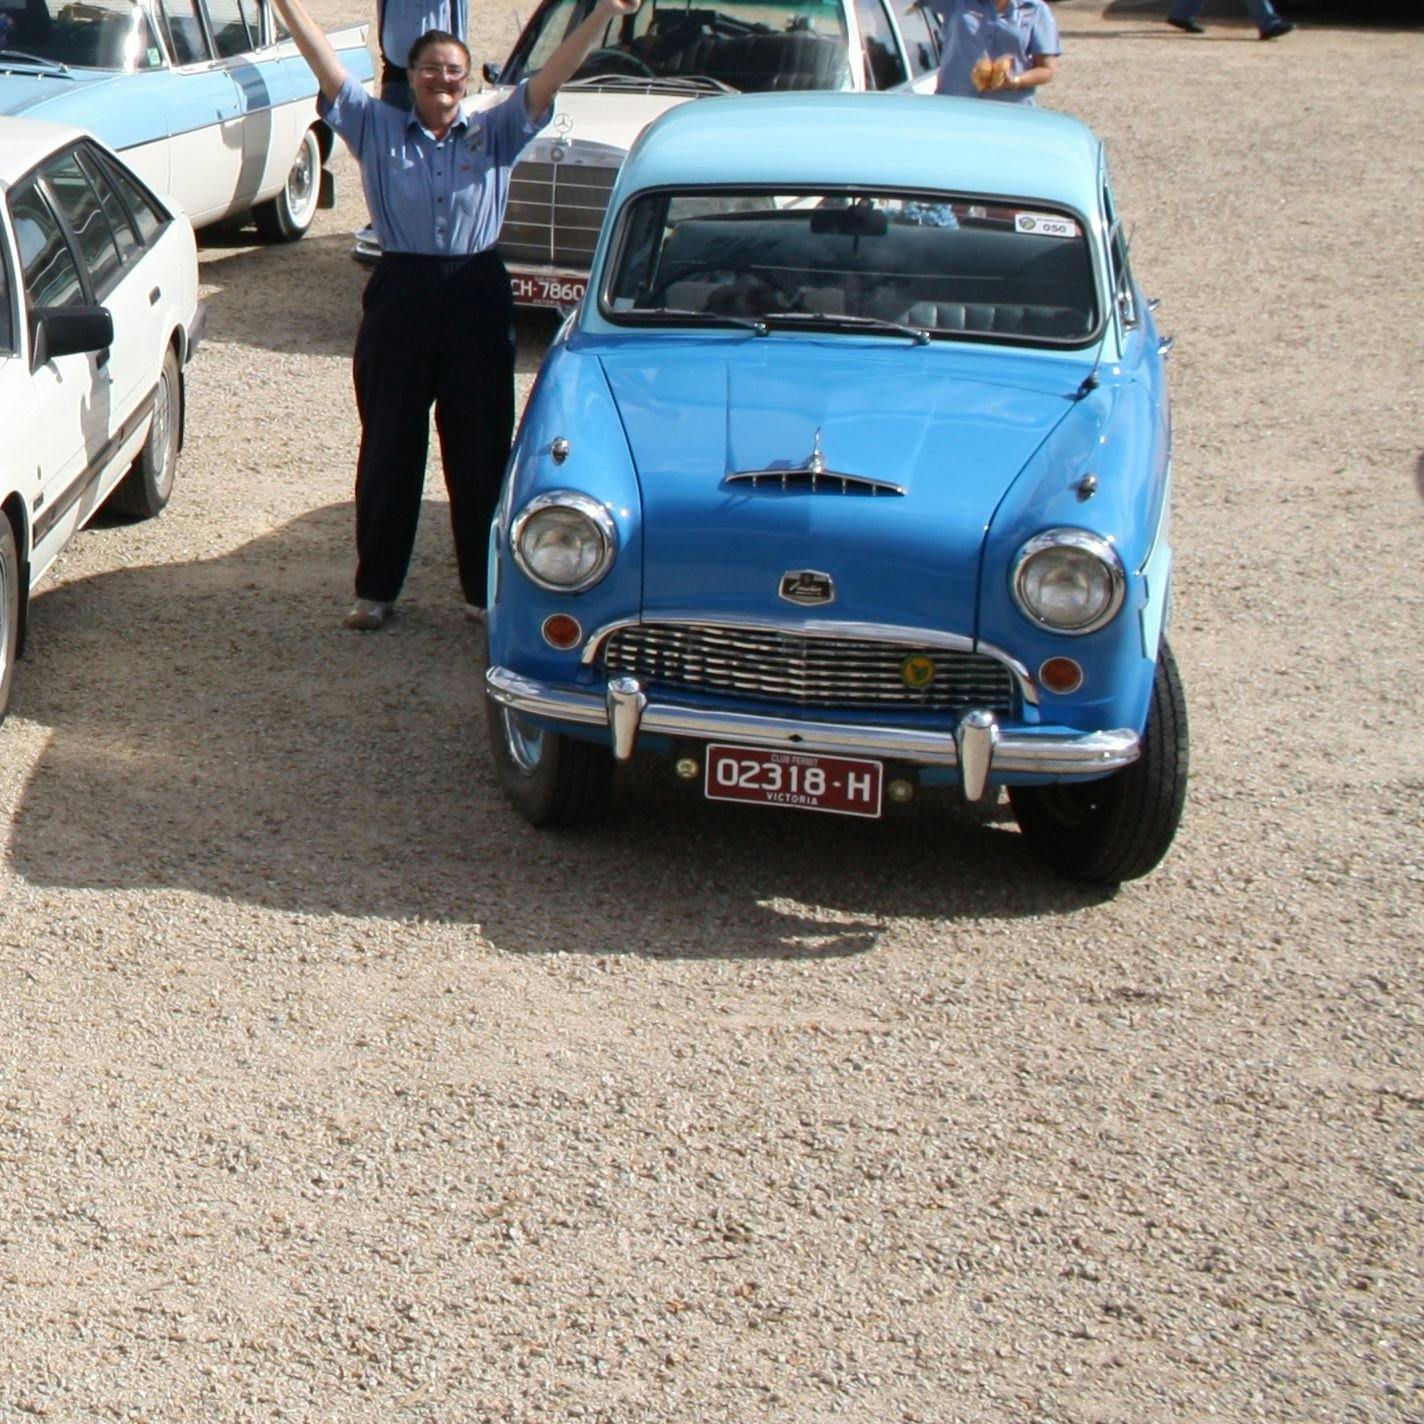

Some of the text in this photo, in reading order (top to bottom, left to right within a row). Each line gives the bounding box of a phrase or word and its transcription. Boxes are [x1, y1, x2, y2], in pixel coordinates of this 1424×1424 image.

[1042, 223, 1067, 233] 050
[770, 753, 819, 767] CLUB PERMIT
[766, 791, 818, 806] VICTORIA
